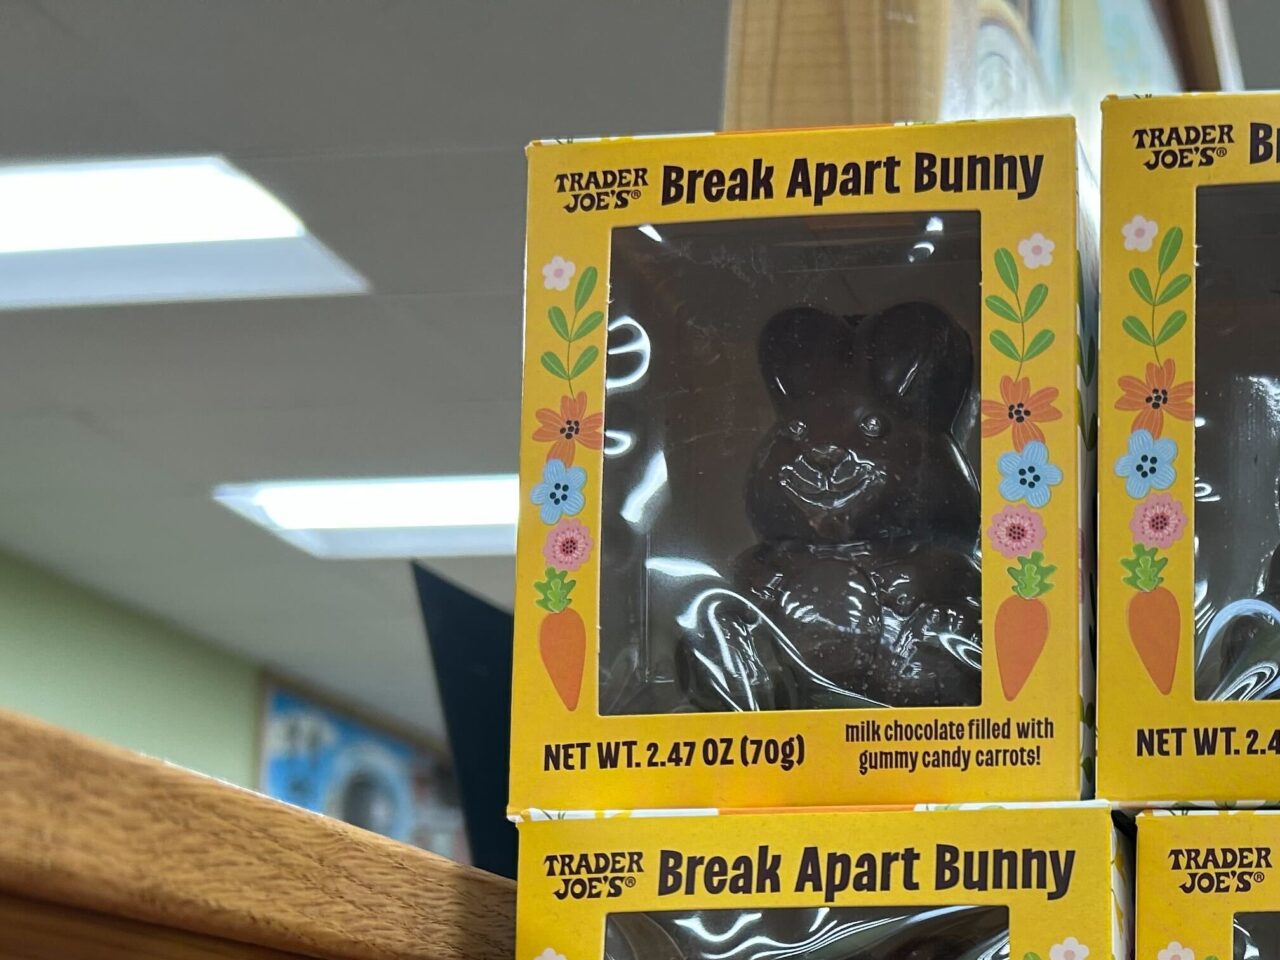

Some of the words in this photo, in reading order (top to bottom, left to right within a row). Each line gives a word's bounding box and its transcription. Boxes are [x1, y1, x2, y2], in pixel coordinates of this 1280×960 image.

[1133, 124, 1234, 150] TRADER
[554, 167, 648, 195] TRADER
[662, 159, 774, 206] Break
[786, 156, 901, 206] Apart
[915, 152, 1044, 200] Bunny
[846, 720, 881, 742] milk
[885, 719, 964, 741] chocolate
[968, 718, 1010, 739] filled
[1016, 717, 1053, 738] with
[1137, 728, 1187, 756] NET
[1194, 727, 1240, 756] WT.
[544, 743, 591, 771] NET
[597, 741, 641, 769] WT.
[647, 742, 696, 767] 2.47
[703, 738, 734, 765] OZ
[741, 734, 804, 771] (70g)
[859, 750, 918, 775] gummy
[922, 746, 971, 771] candy
[976, 746, 1040, 766] carrots!
[544, 852, 644, 876] TRADER
[658, 845, 781, 896] Break
[794, 847, 920, 902] Apart
[935, 844, 1075, 900] Bunny
[1168, 848, 1272, 870] TRADER
